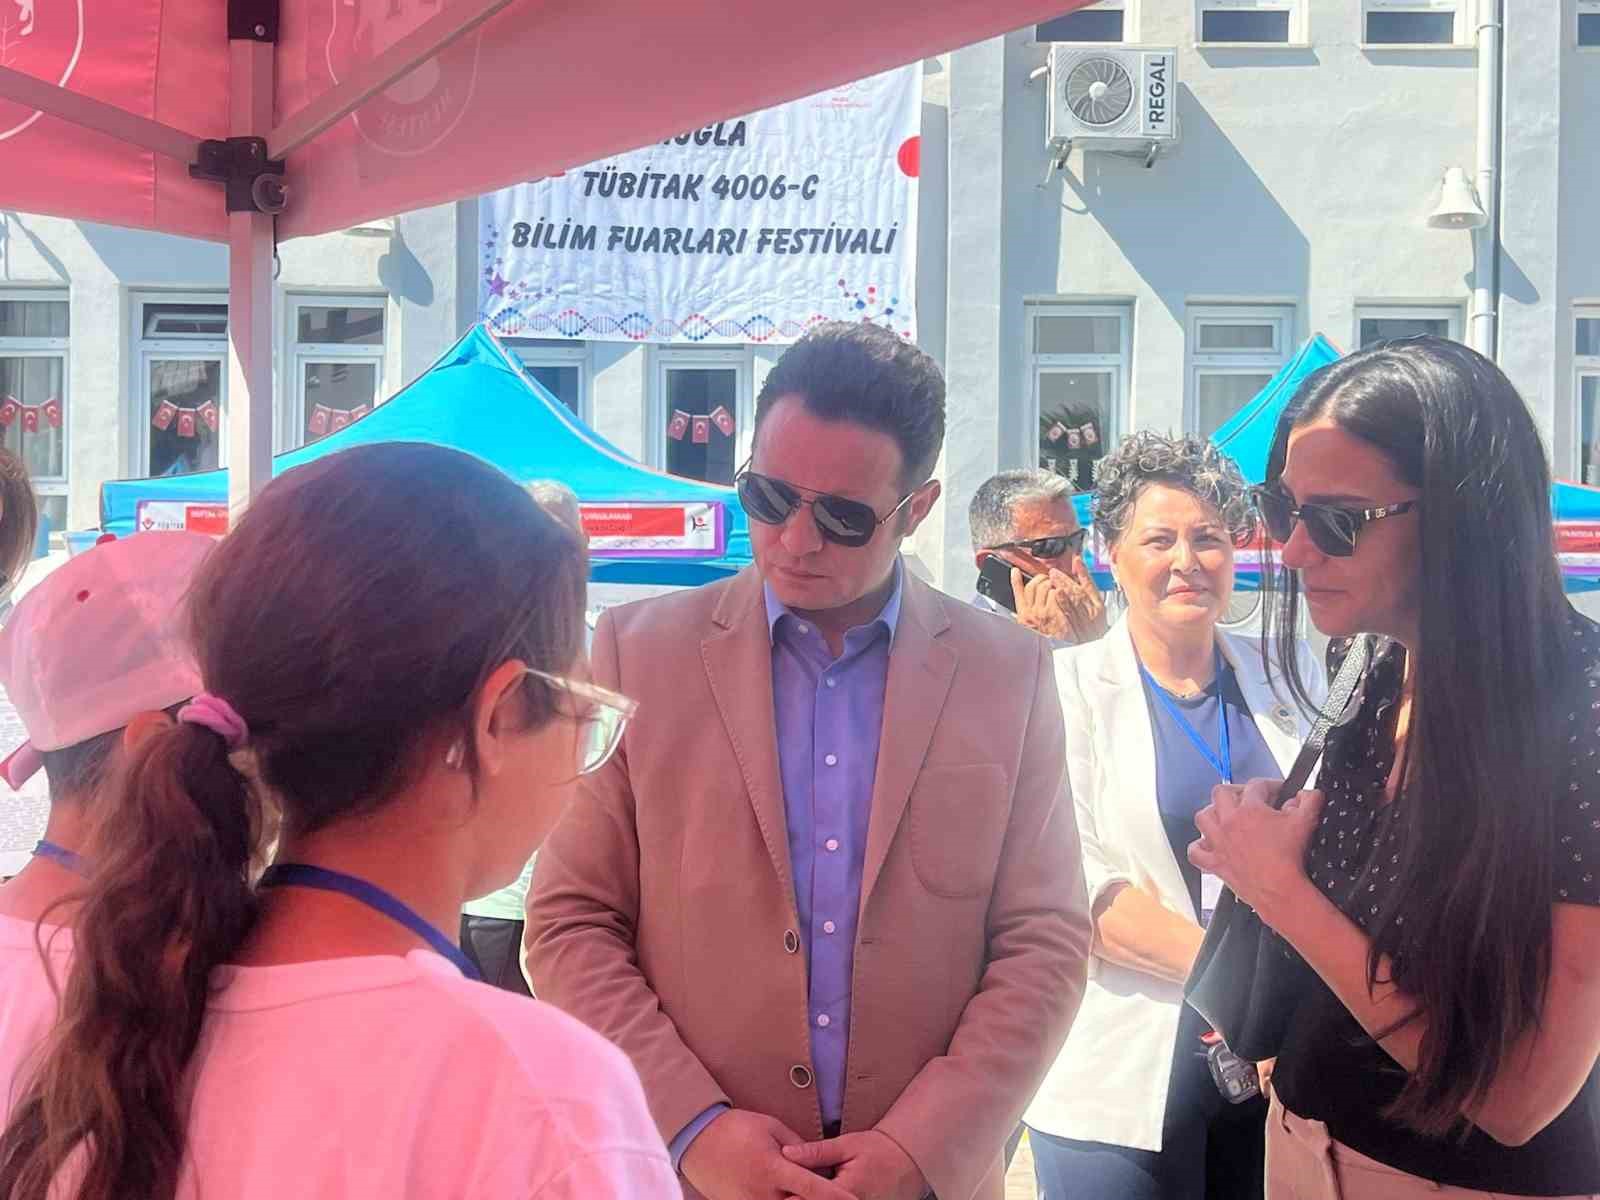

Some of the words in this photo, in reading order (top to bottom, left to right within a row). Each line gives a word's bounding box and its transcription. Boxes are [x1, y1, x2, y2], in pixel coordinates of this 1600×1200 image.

[1149, 56, 1166, 123] REGAL
[583, 166, 704, 201] TÜBİTAK
[711, 174, 819, 200] 4006-C
[511, 216, 597, 251] BİLİM
[607, 225, 748, 256] FUARLARI
[756, 221, 898, 254] FESTİVALİ
